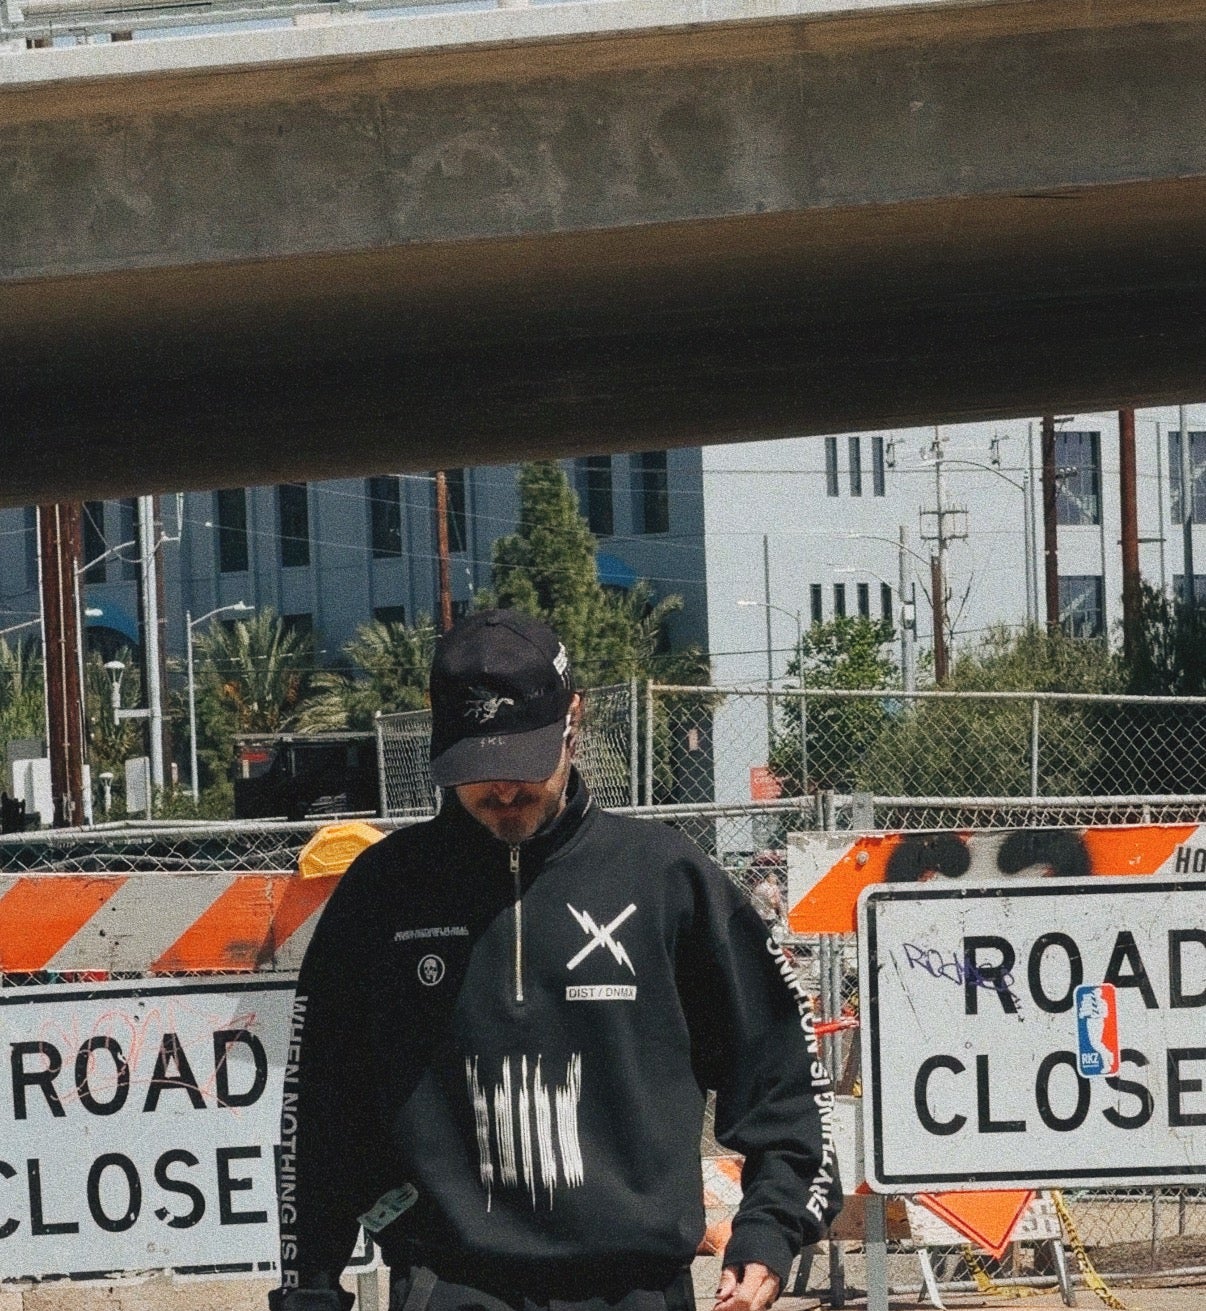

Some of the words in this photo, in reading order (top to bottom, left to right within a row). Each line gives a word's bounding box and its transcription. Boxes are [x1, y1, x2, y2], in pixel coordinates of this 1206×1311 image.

[568, 987, 595, 998] DIST
[963, 928, 1206, 1016] ROAD
[9, 1029, 268, 1120] ROAD
[810, 1061, 831, 1087] IS
[1081, 1052, 1099, 1065] RKZ
[281, 1093, 299, 1224] NOTHING
[0, 1145, 281, 1240] LOSE
[281, 1234, 299, 1260] IS
